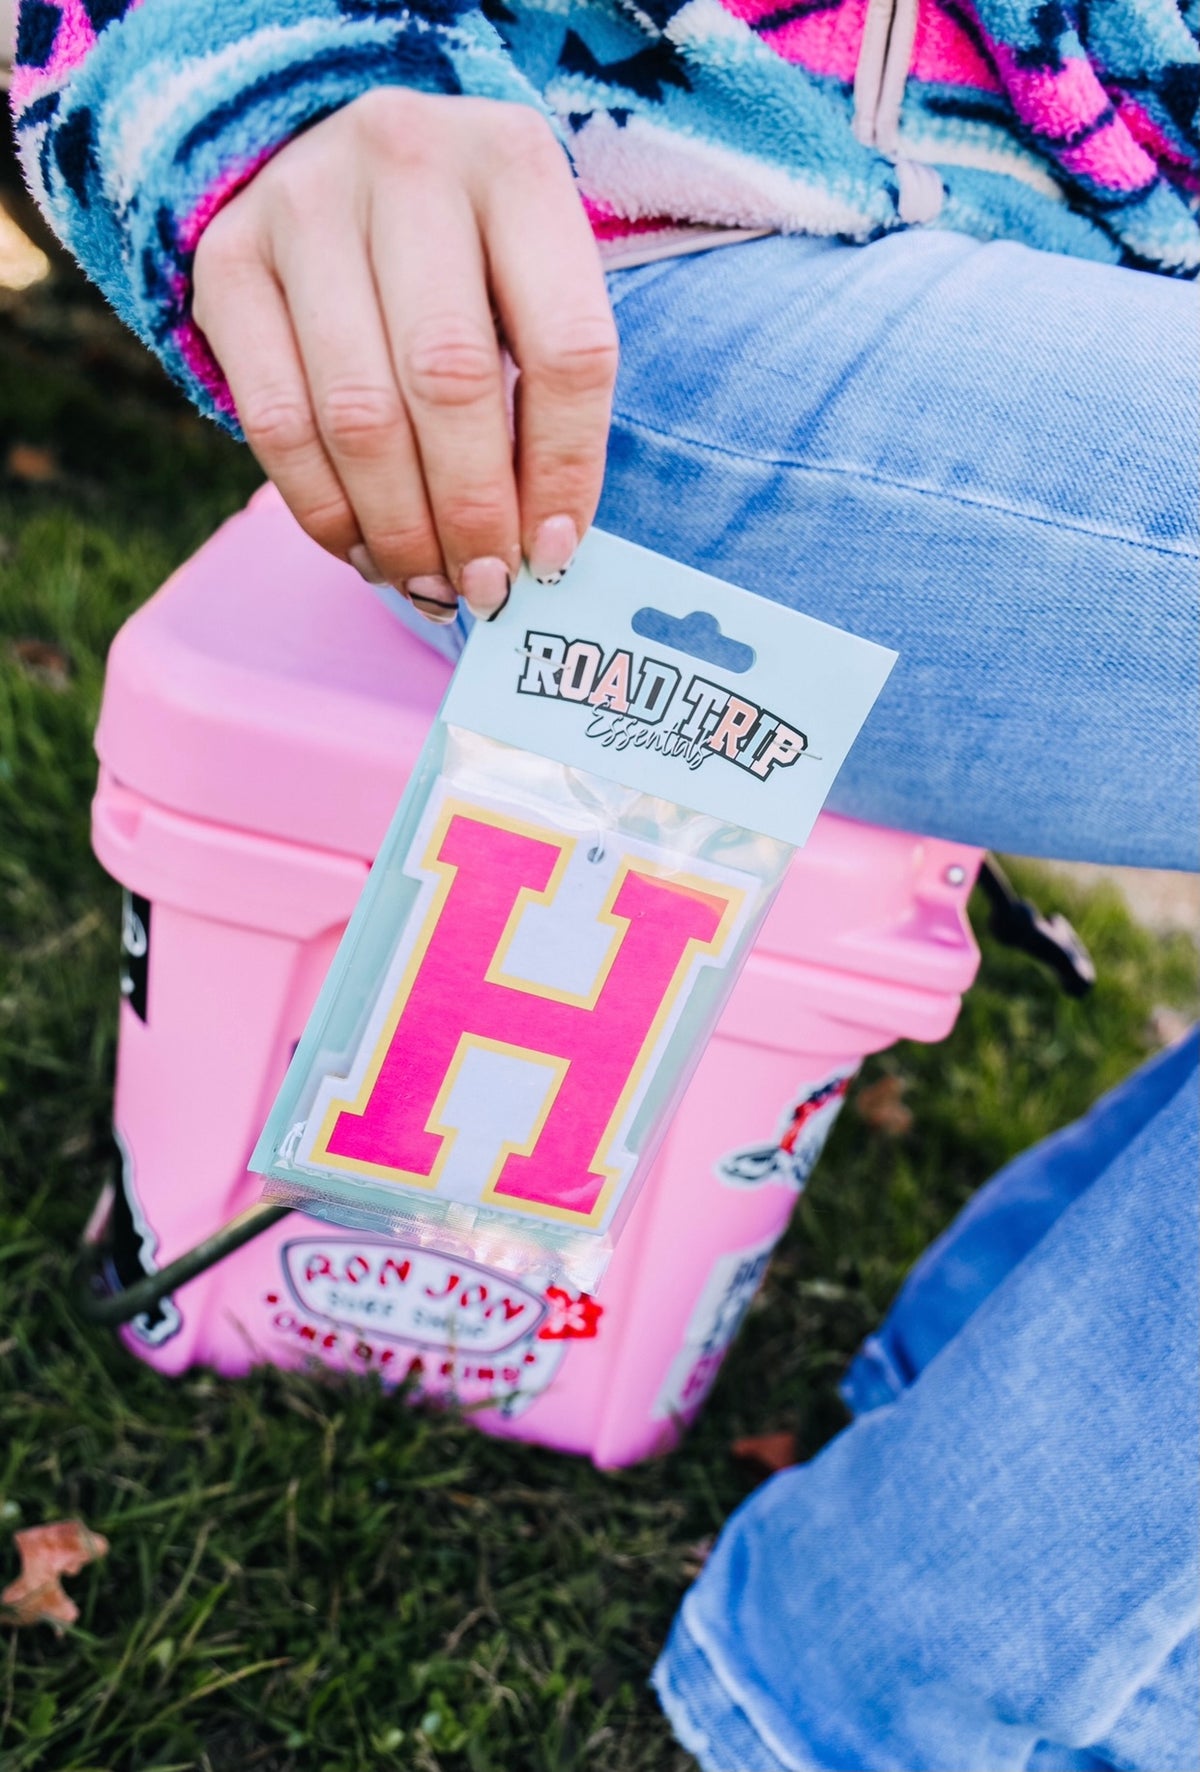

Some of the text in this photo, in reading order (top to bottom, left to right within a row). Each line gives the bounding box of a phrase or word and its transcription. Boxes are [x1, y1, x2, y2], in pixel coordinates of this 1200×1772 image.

[517, 630, 808, 782] ROAD TRIP
[585, 694, 715, 770] Essentials
[310, 798, 747, 1228] H
[306, 1254, 525, 1320] RON JON
